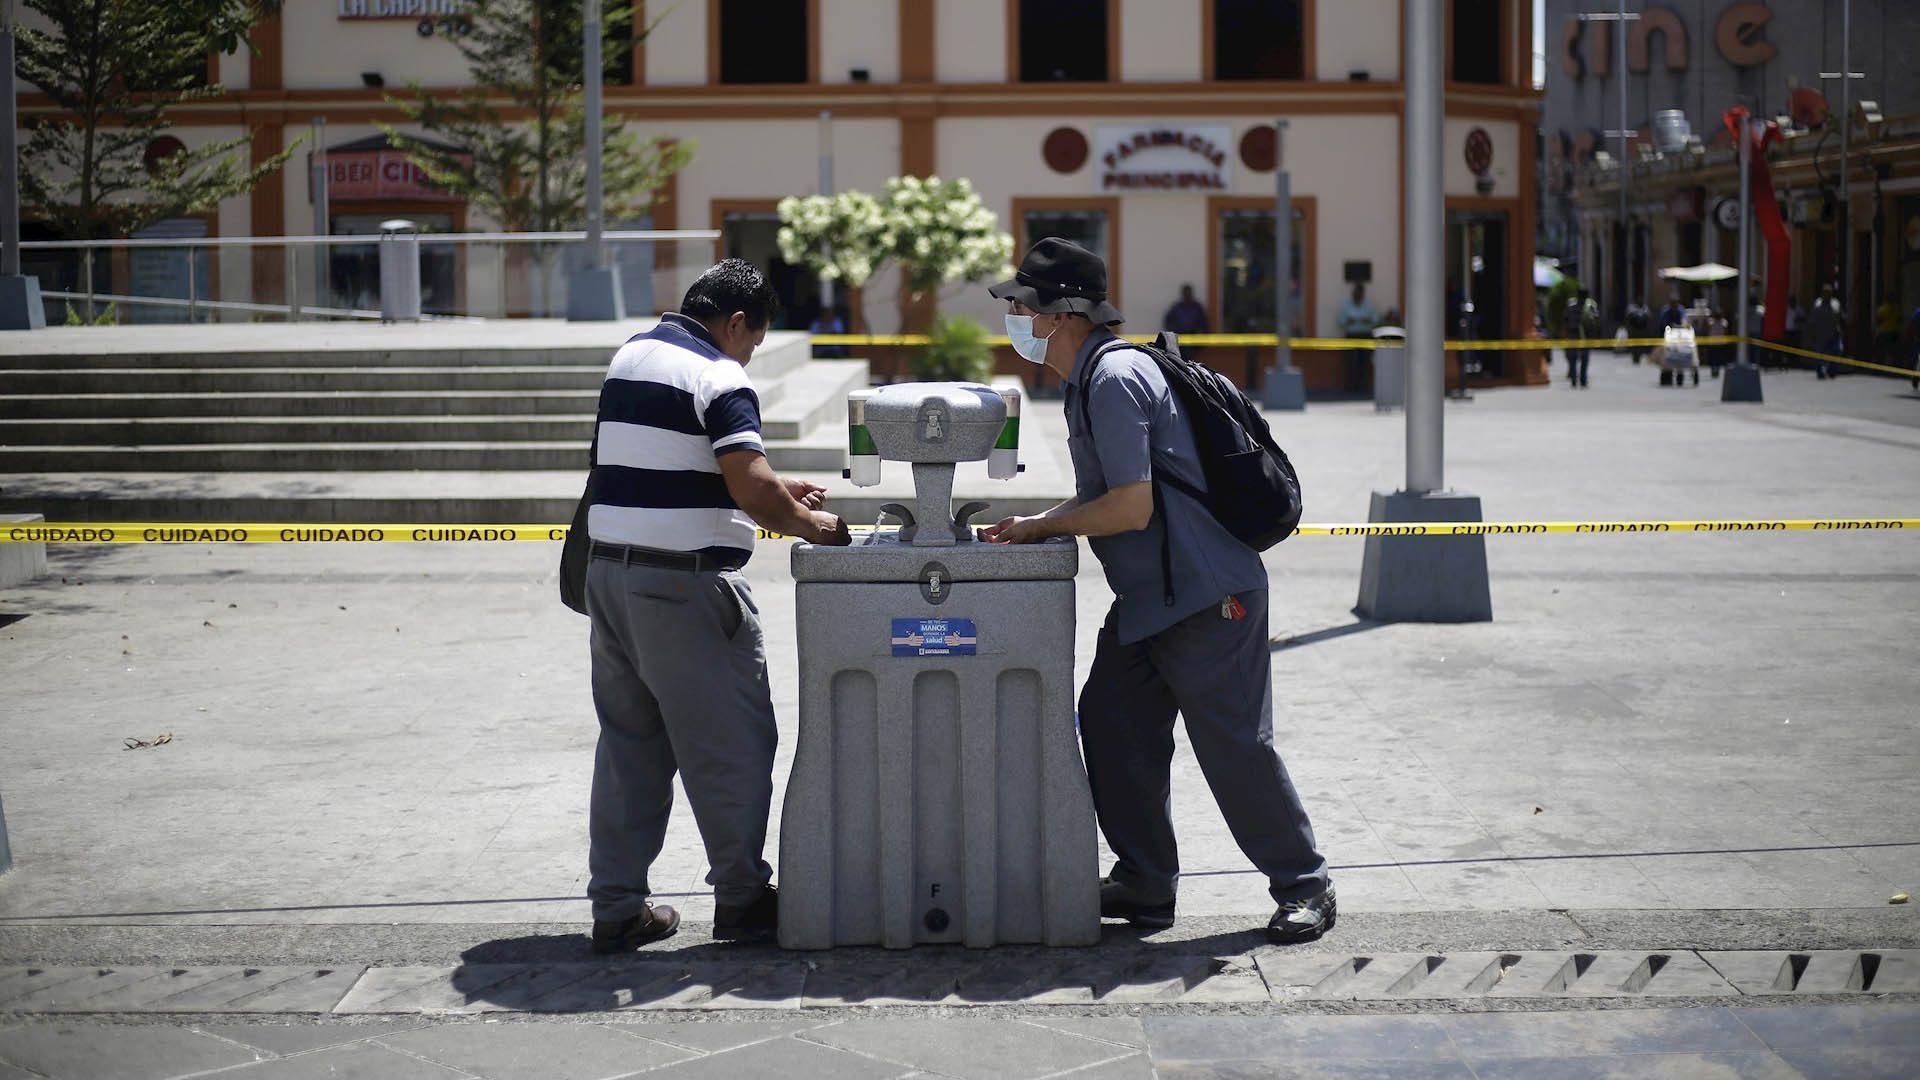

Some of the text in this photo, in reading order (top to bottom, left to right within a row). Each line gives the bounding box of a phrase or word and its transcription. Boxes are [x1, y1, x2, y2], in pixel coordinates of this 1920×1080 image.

[1104, 130, 1225, 167] FARMACIA
[1104, 173, 1225, 189] PRINCIPAL
[9, 528, 115, 542] CUIDADO
[143, 528, 248, 542] CUIDADO
[280, 528, 384, 542] CUIDADO
[412, 528, 516, 542] CUIDADO
[931, 883, 940, 898] F
